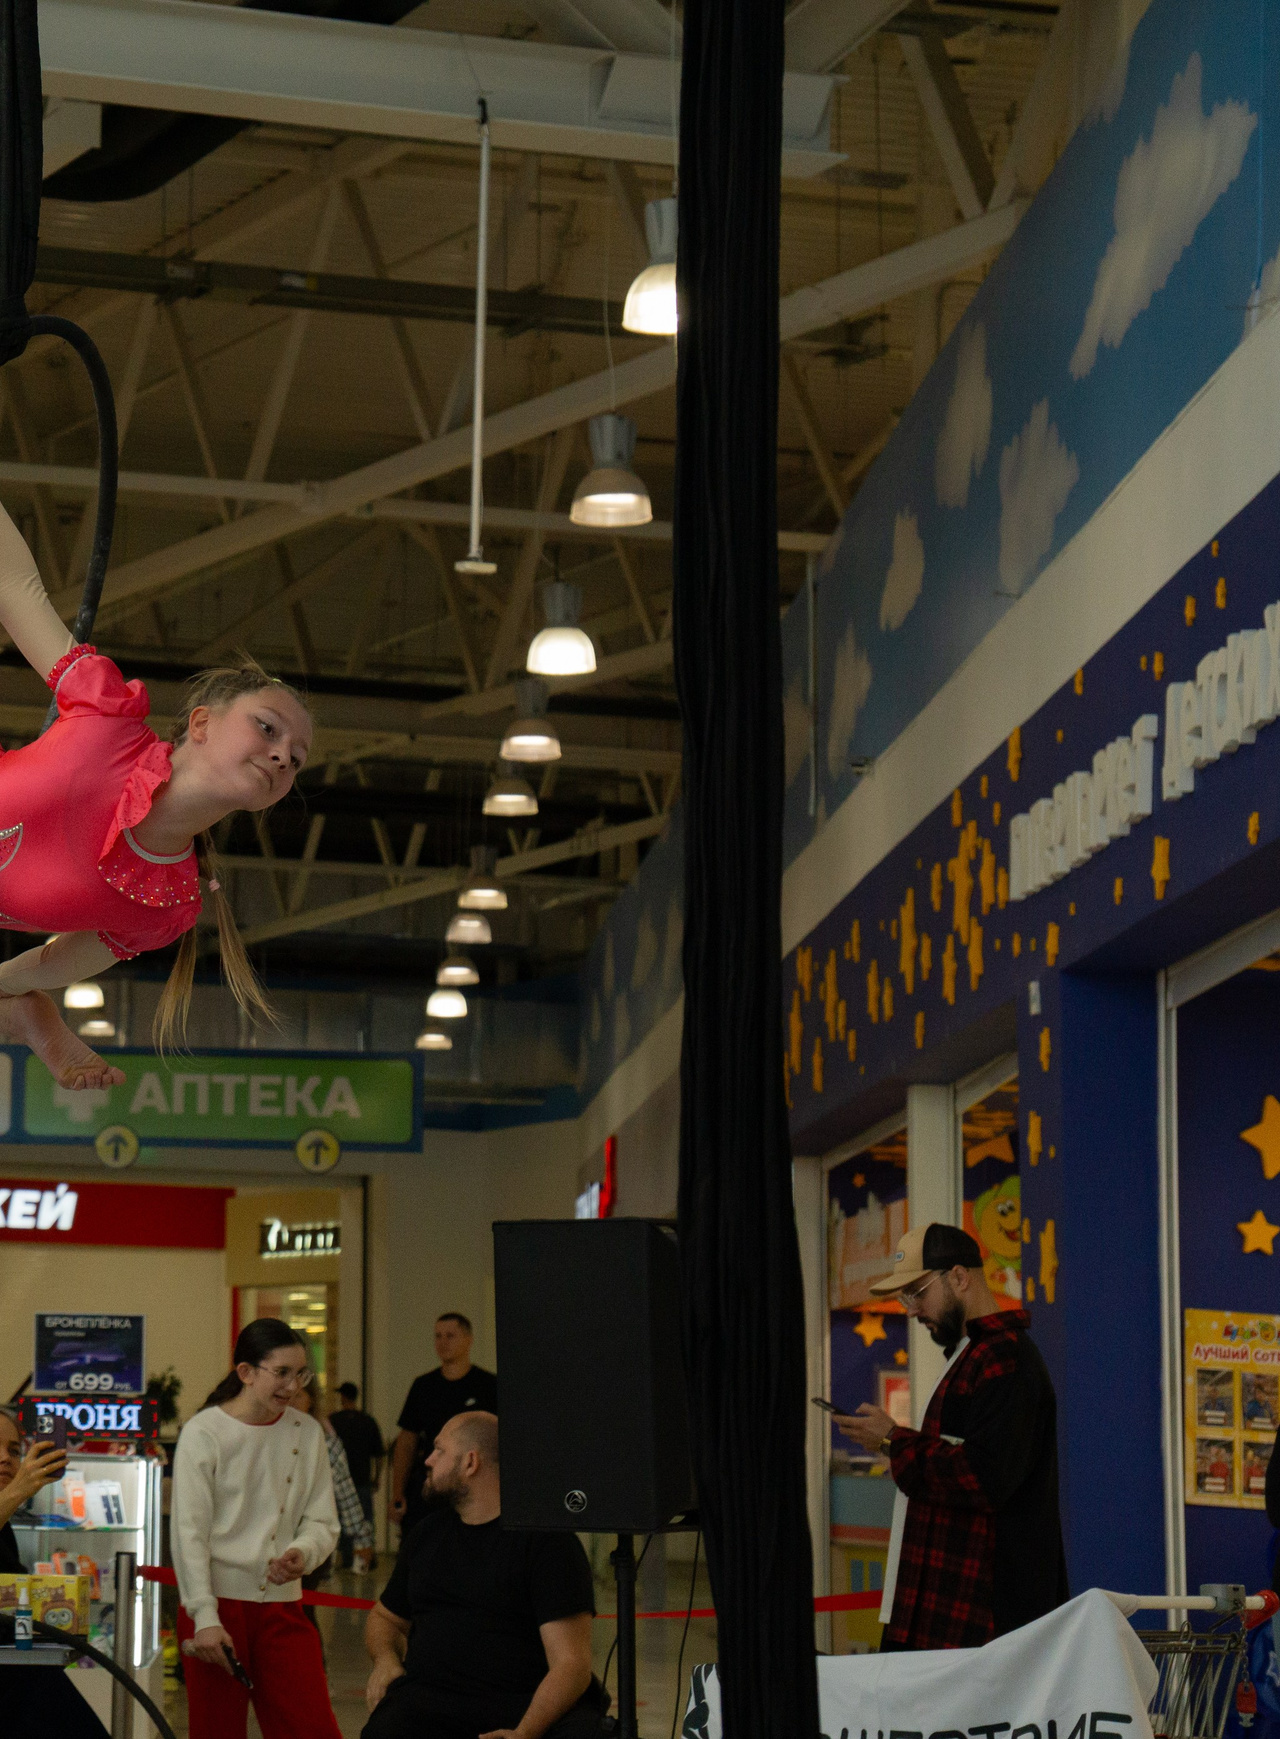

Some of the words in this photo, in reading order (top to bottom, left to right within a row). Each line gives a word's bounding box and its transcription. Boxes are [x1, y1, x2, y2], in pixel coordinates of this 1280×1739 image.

[129, 1072, 362, 1118] АПТЕКА
[45, 1316, 132, 1329] БРОНЕПЛЁНКА
[69, 1373, 114, 1391] 699
